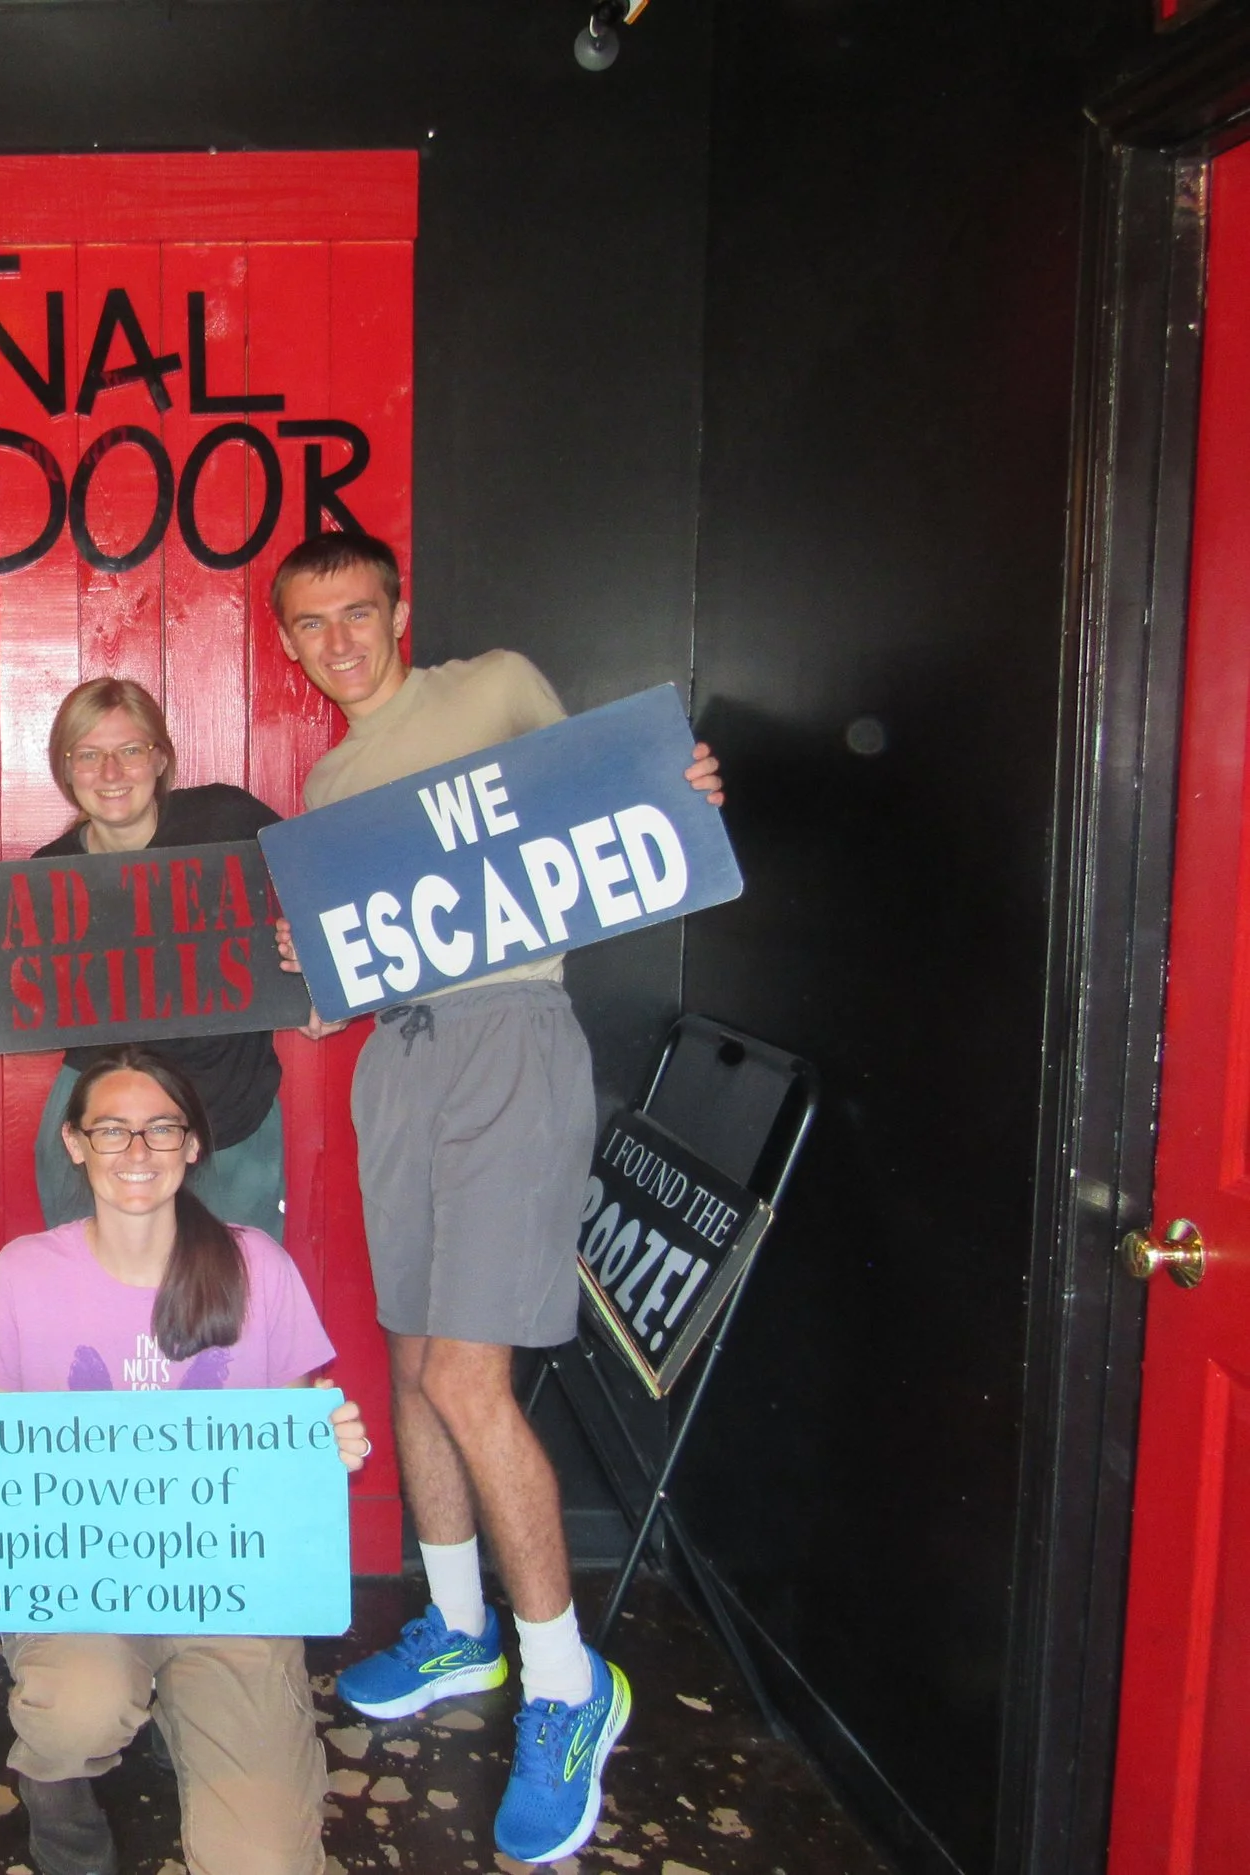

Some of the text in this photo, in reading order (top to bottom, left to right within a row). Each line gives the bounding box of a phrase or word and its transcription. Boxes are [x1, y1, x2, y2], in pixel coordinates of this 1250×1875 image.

[417, 762, 520, 852] WE
[318, 804, 688, 1008] ESCAPED
[10, 937, 255, 1031] SKILLS
[602, 1128, 739, 1248] I FOUND THE
[136, 1332, 159, 1359] I'M
[123, 1358, 171, 1383] NUTS
[34, 1472, 179, 1506] Power
[190, 1467, 240, 1505] of
[79, 1521, 219, 1568] People
[230, 1523, 266, 1559] in
[91, 1577, 247, 1623] Groups
